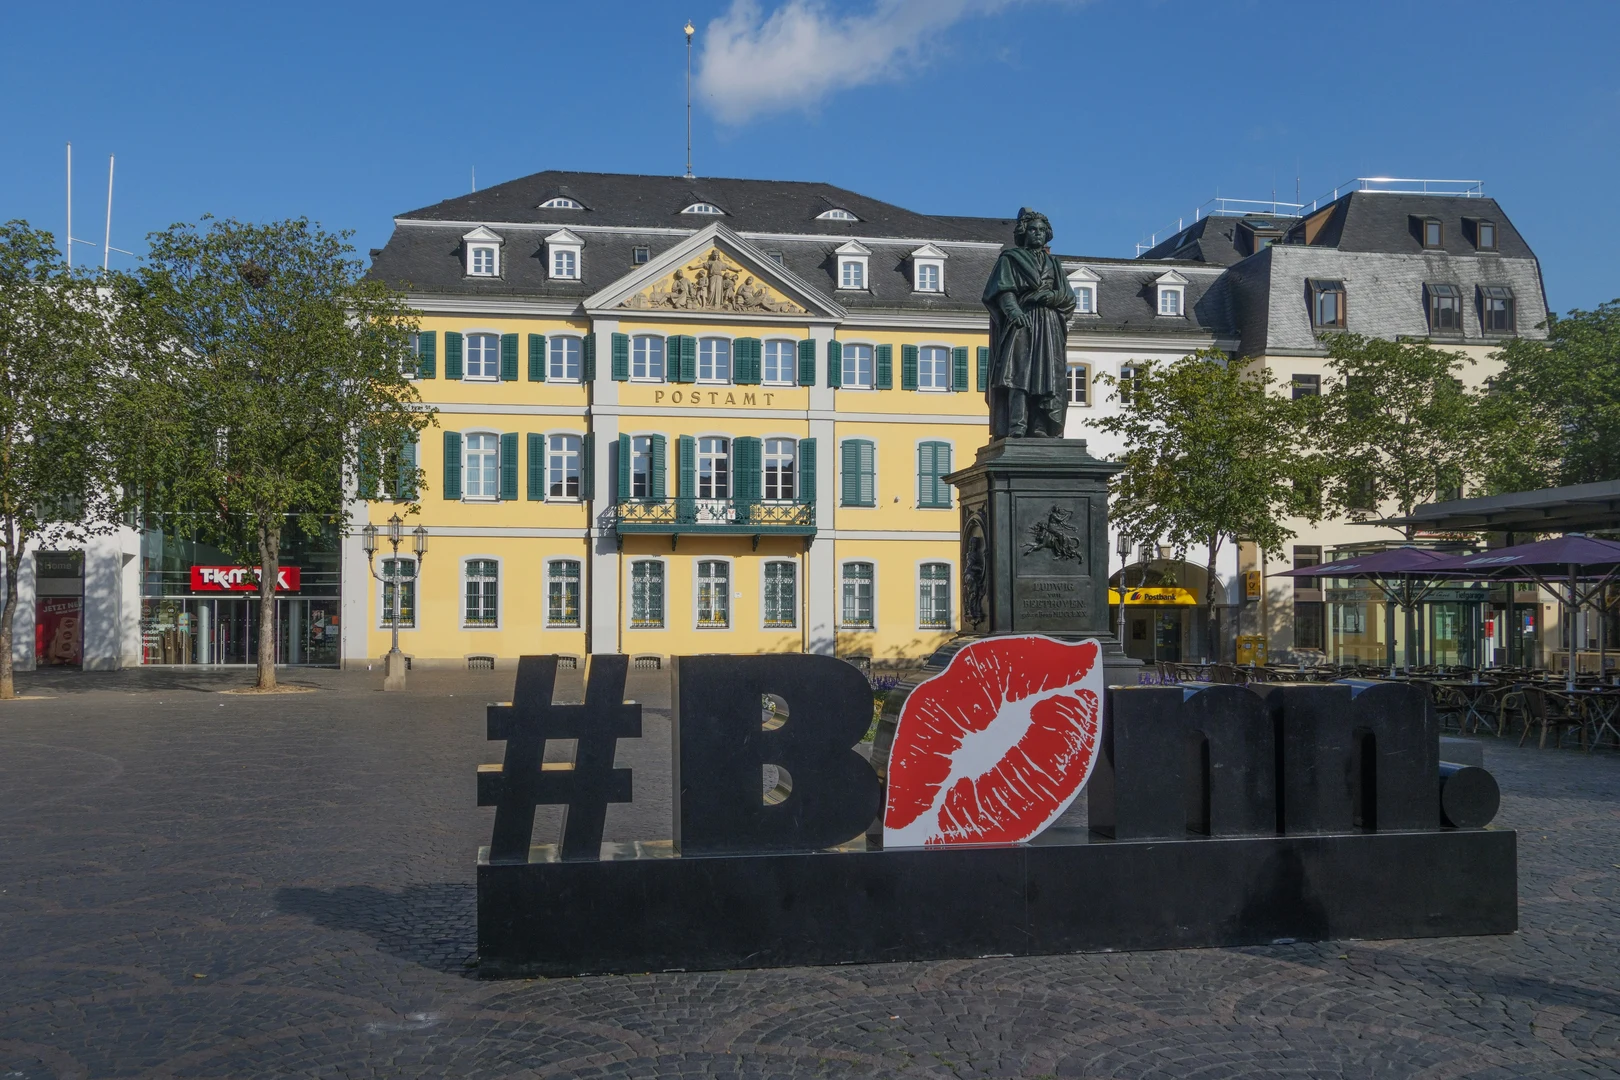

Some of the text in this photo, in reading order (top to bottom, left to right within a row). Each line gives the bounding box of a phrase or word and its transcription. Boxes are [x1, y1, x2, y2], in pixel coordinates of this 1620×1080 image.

[654, 390, 775, 405] POSTAMT
[1033, 582, 1075, 592] LUDWIG
[1144, 593, 1176, 601] Postbank
[1455, 591, 1485, 600] Tiefgarage
[43, 603, 66, 613] JETZT
[477, 642, 1500, 864] #Bnn.
